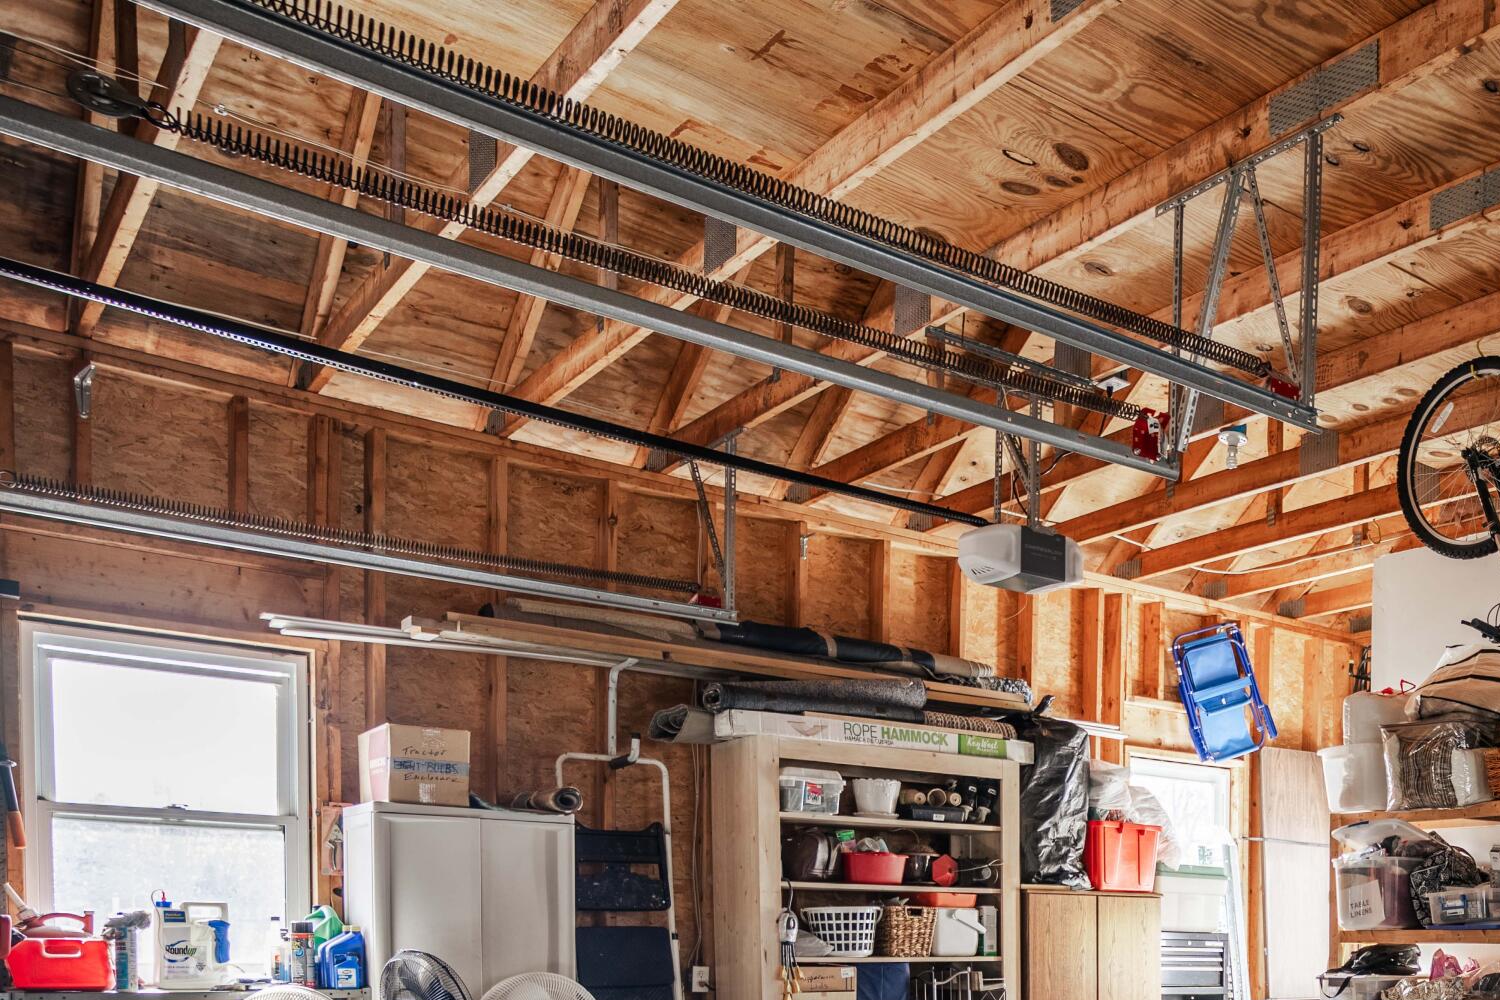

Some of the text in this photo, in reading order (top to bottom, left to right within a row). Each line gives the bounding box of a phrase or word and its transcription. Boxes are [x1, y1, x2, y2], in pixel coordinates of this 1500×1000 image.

[843, 722, 949, 747] ROPE HAMMOCK
[165, 944, 198, 957] Roundup
